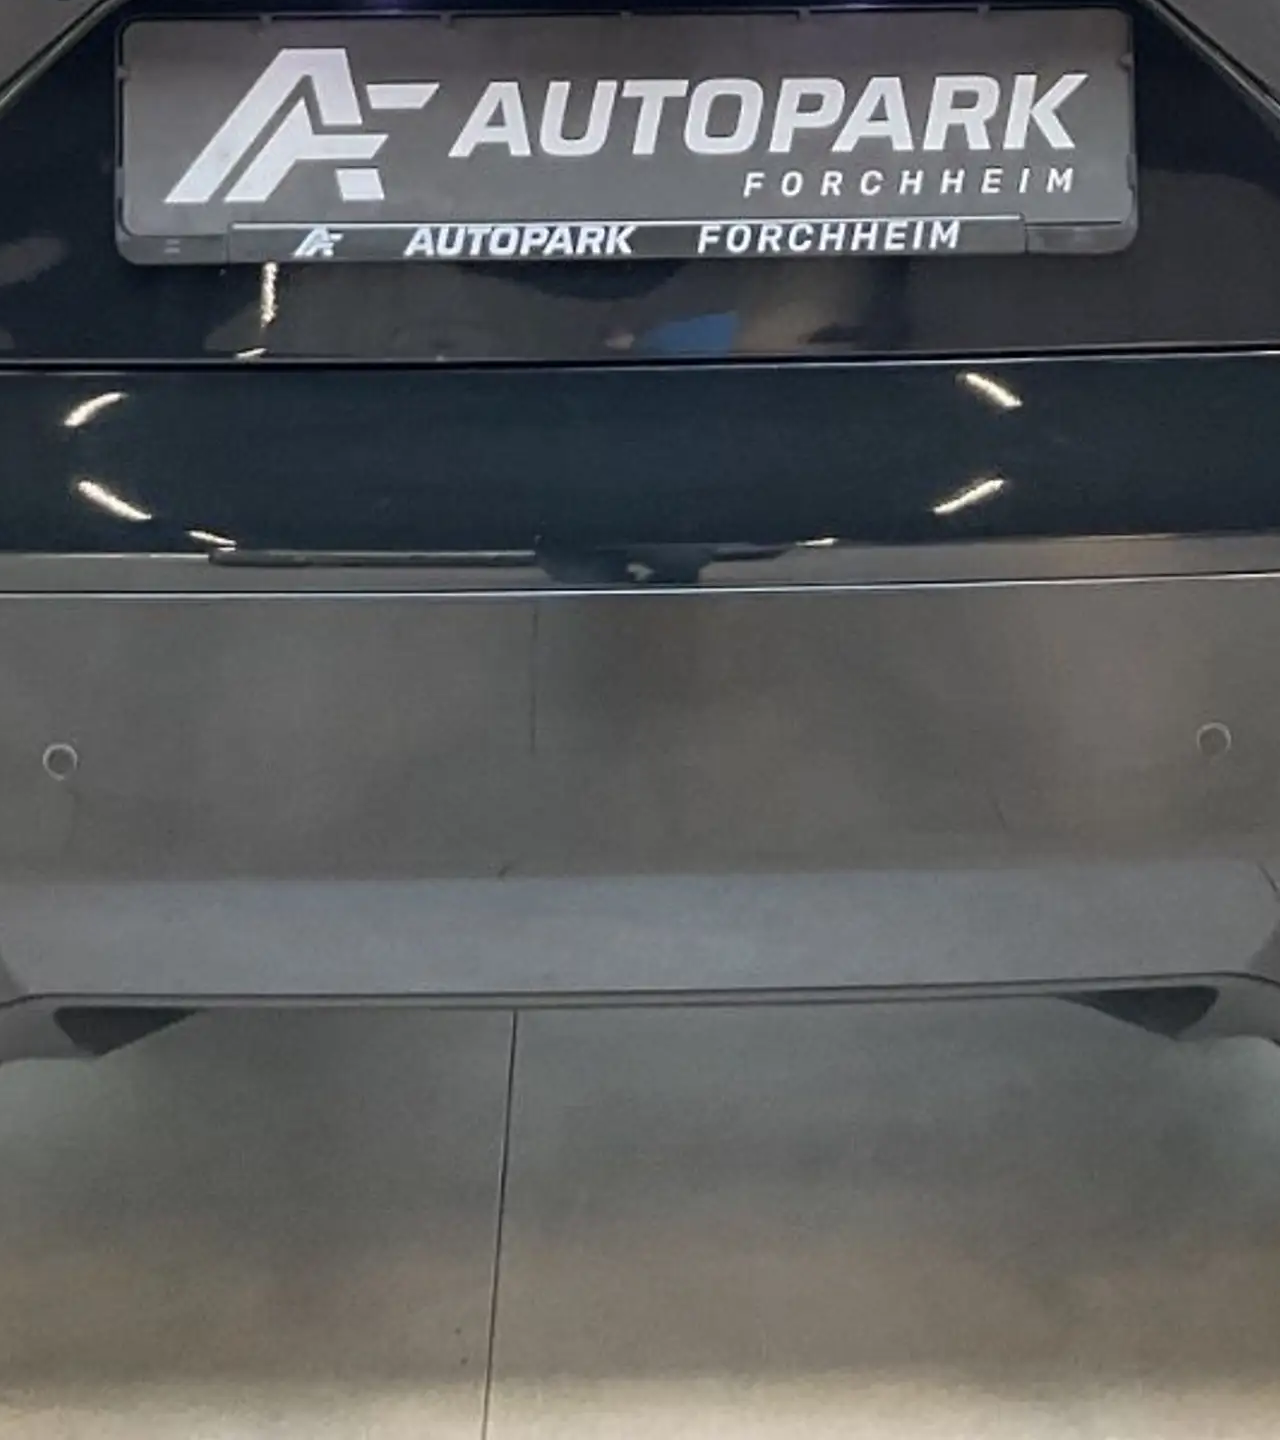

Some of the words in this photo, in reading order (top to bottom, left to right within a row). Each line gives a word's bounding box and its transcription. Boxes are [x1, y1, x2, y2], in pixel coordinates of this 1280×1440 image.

[448, 73, 1088, 159] AUTOPARK
[743, 167, 1076, 198] FORCHHEIM
[405, 226, 634, 257] AUTOPARK
[698, 220, 961, 253] FORCHHEIM
